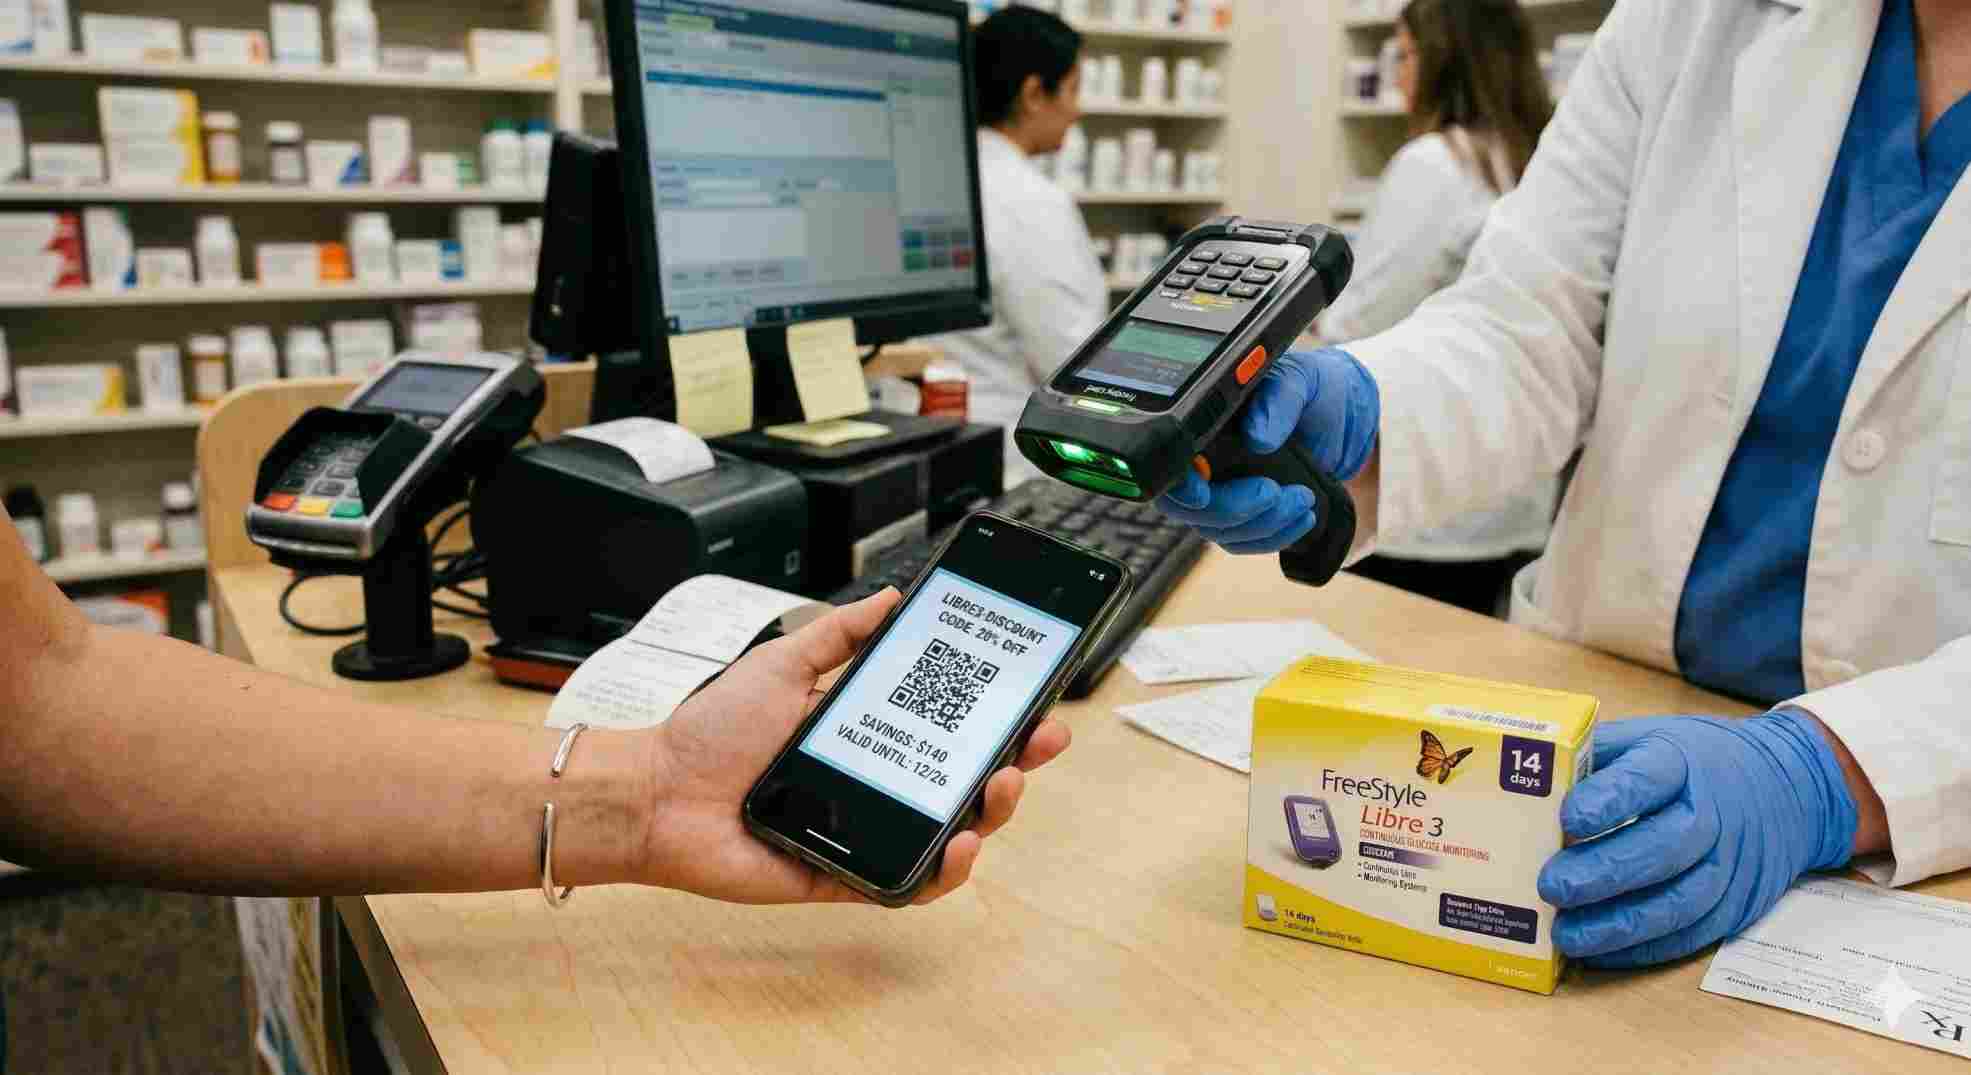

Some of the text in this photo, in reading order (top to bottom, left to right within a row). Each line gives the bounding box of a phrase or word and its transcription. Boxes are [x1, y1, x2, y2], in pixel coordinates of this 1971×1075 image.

[938, 611, 1029, 656] CODE 20% OFF
[837, 724, 949, 787] VALID UNTIL: 12/26
[859, 713, 948, 763] SAVINGS: $140
[1510, 773, 1541, 788] days
[1511, 749, 1542, 773] 14
[1322, 768, 1427, 808] FreeStyle
[1361, 804, 1444, 837] Libre 3
